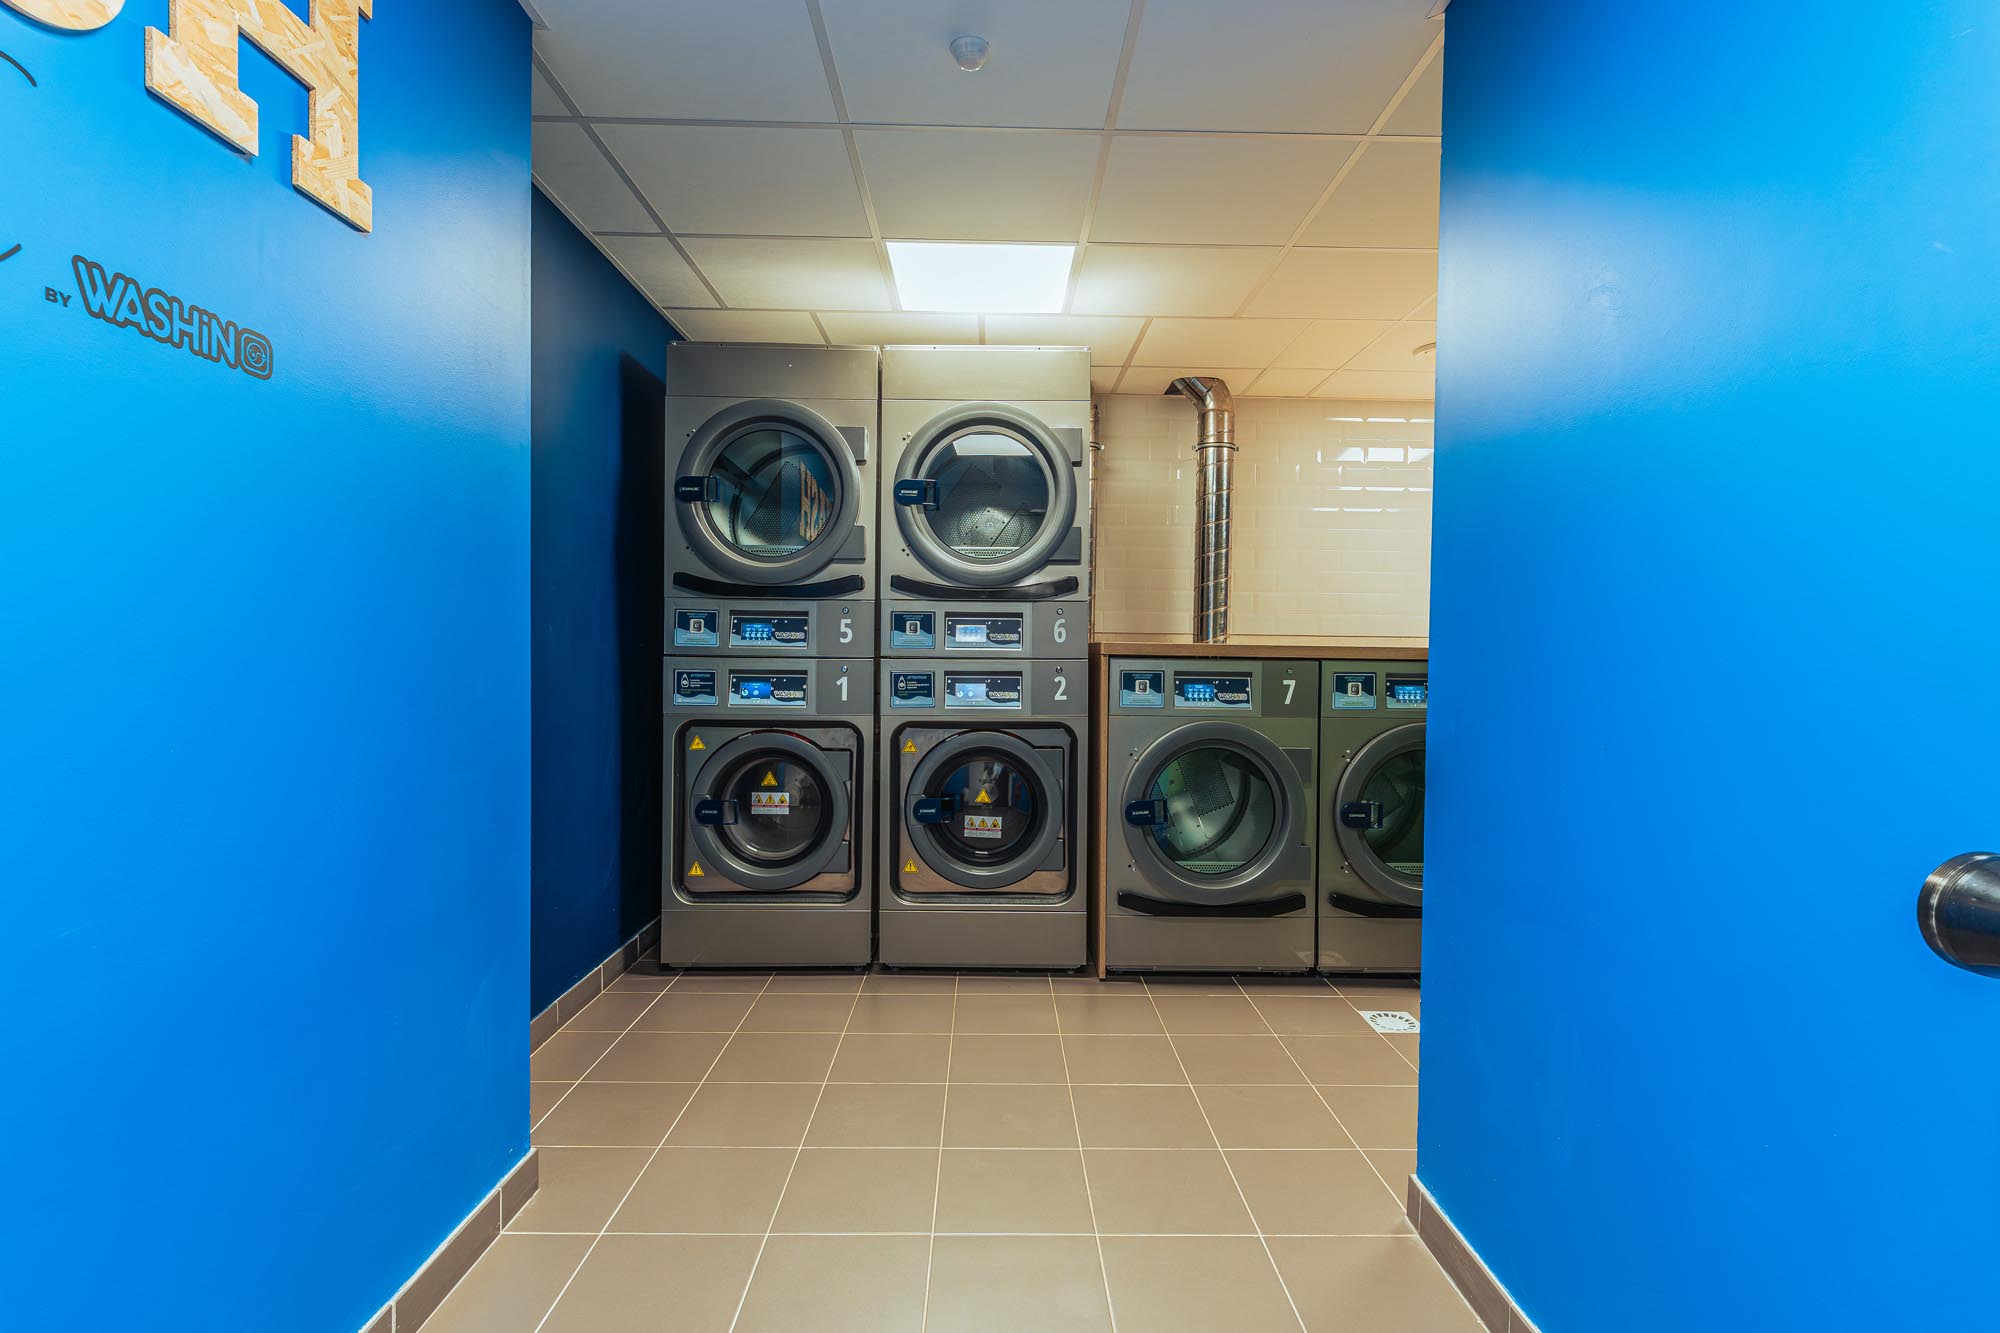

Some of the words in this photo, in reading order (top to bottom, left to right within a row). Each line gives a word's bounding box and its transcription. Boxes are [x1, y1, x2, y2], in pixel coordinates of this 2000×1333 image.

[45, 286, 72, 308] BY
[839, 618, 853, 644] 5
[1053, 618, 1067, 644] 6
[836, 676, 848, 701] 1
[1054, 676, 1067, 701] 2
[1282, 679, 1296, 705] 7
